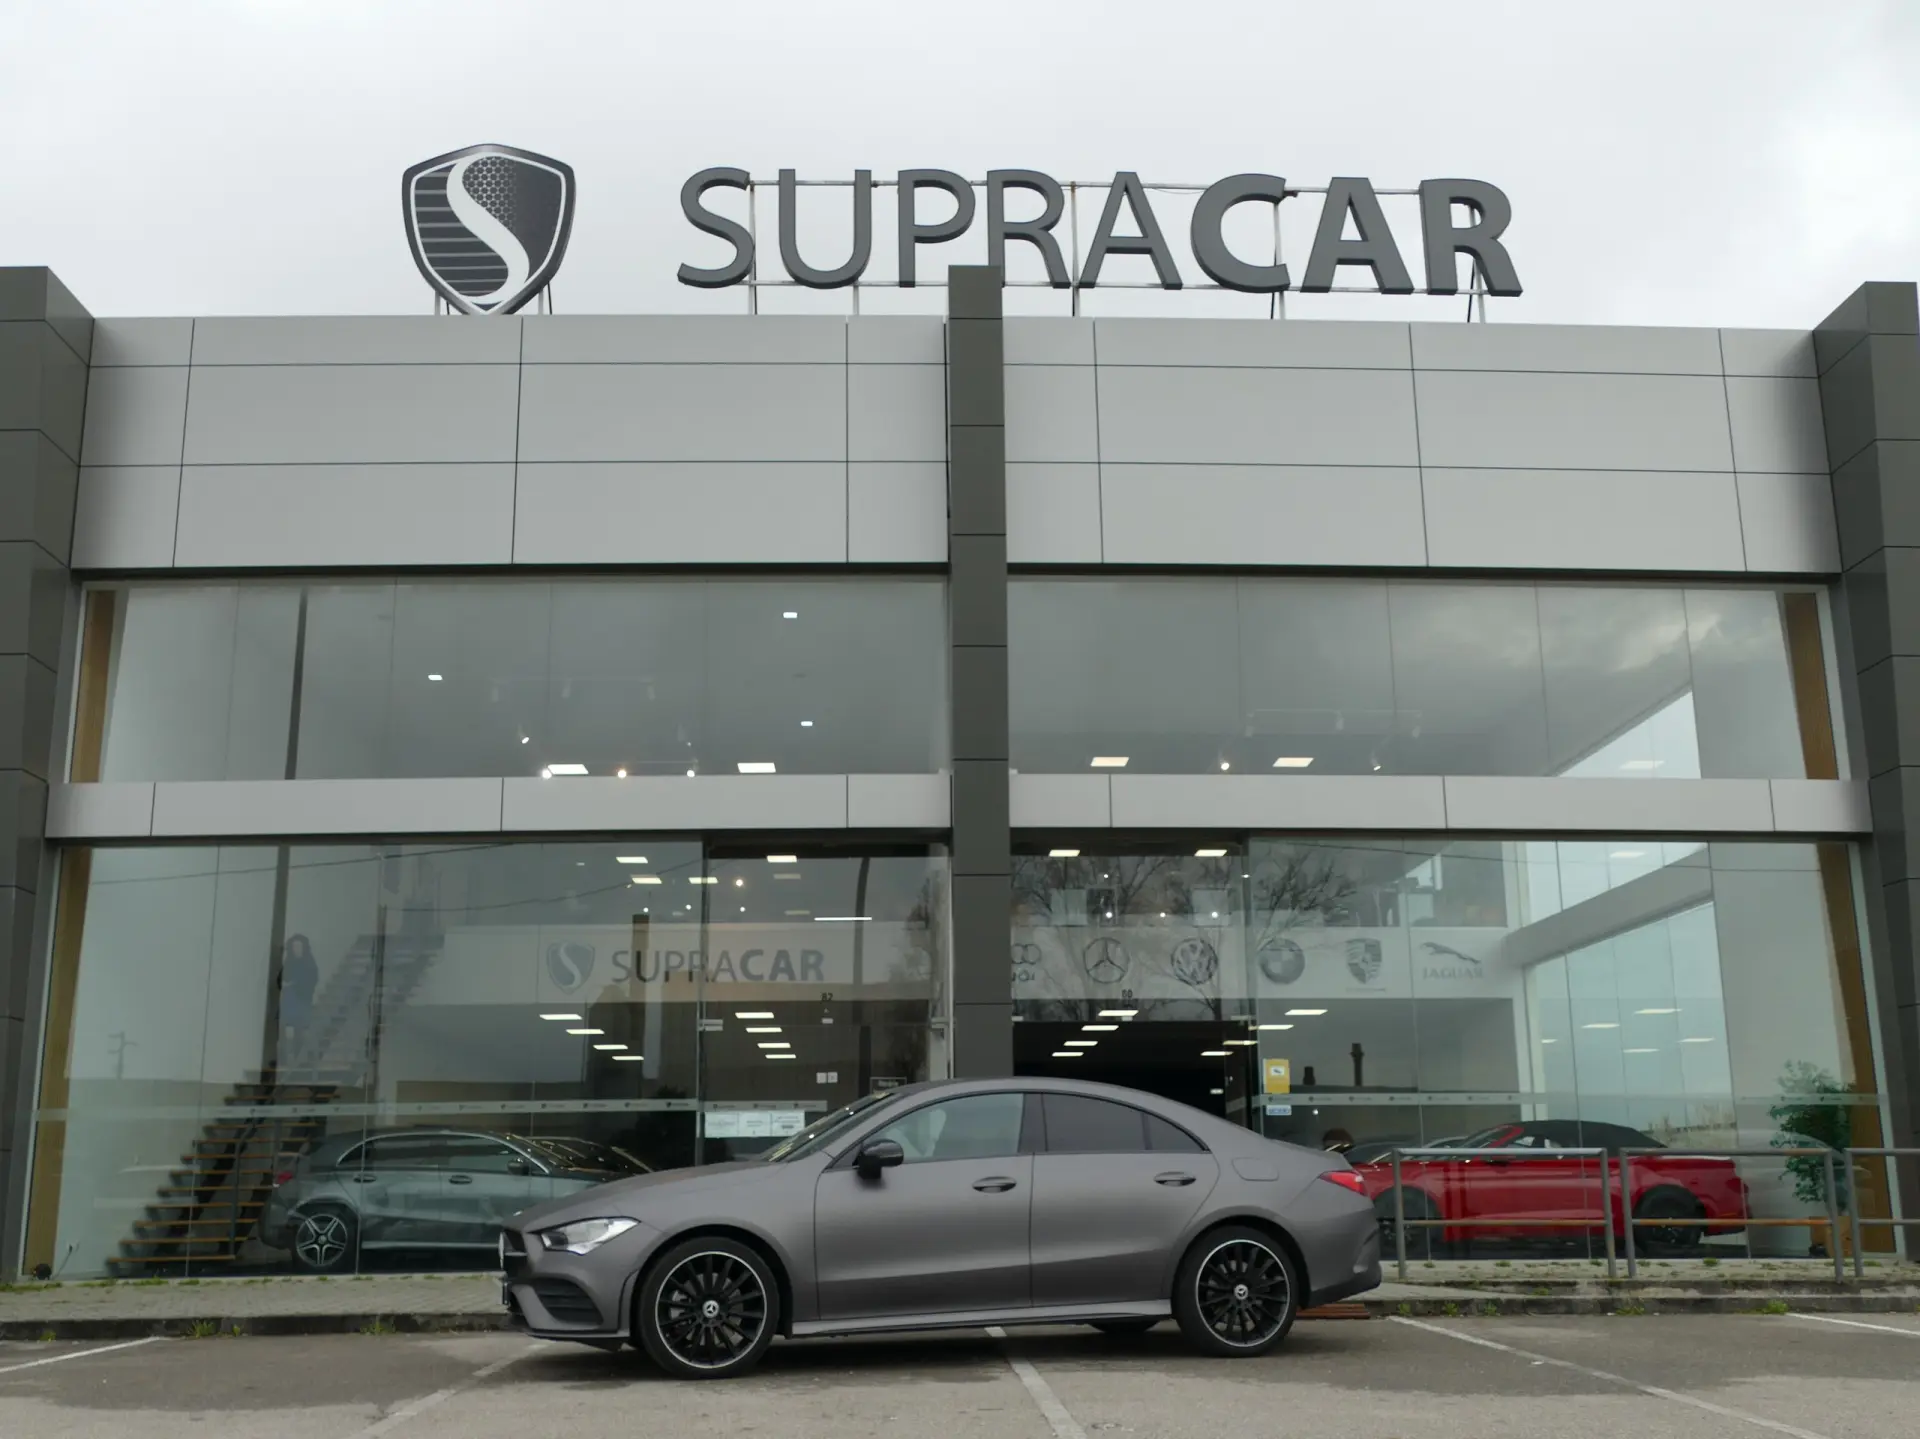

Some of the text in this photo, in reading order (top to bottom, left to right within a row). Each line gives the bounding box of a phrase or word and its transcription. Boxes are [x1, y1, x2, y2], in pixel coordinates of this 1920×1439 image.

[677, 167, 1523, 297] SUPRACAR
[611, 948, 825, 983] SUPRACAR
[1422, 966, 1485, 980] JAGUAR
